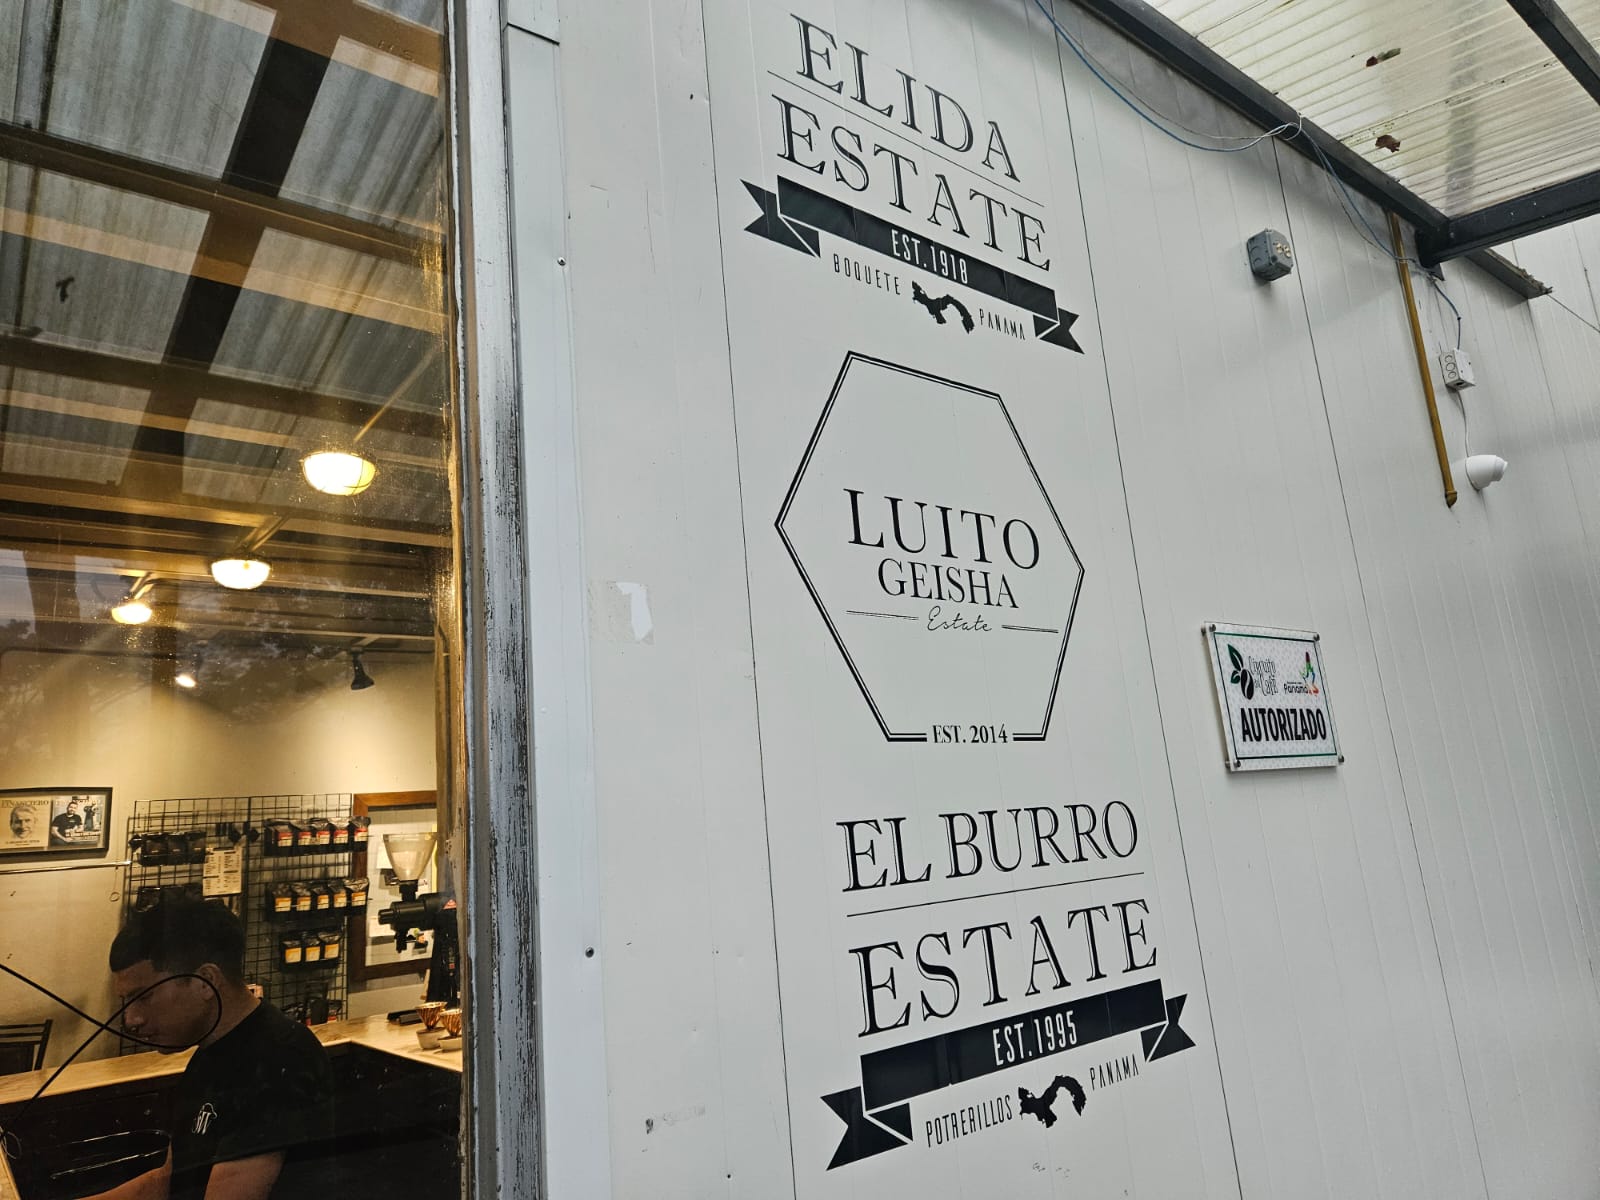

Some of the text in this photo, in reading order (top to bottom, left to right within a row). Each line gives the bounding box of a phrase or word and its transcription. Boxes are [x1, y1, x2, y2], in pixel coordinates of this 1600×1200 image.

[790, 13, 1021, 183] ELIDA
[771, 94, 1050, 272] ESTATE
[833, 253, 1026, 341] BOQUETE PANAMA
[843, 488, 1040, 570] LUITO
[877, 557, 1020, 609] GEISHA
[926, 605, 992, 632] Estate
[1240, 707, 1327, 743] AUTORIZADO
[836, 800, 1139, 893] EL BURRO
[848, 898, 1157, 1038] ESTATE
[926, 1053, 1140, 1148] POTRERILLOS PANAMA
